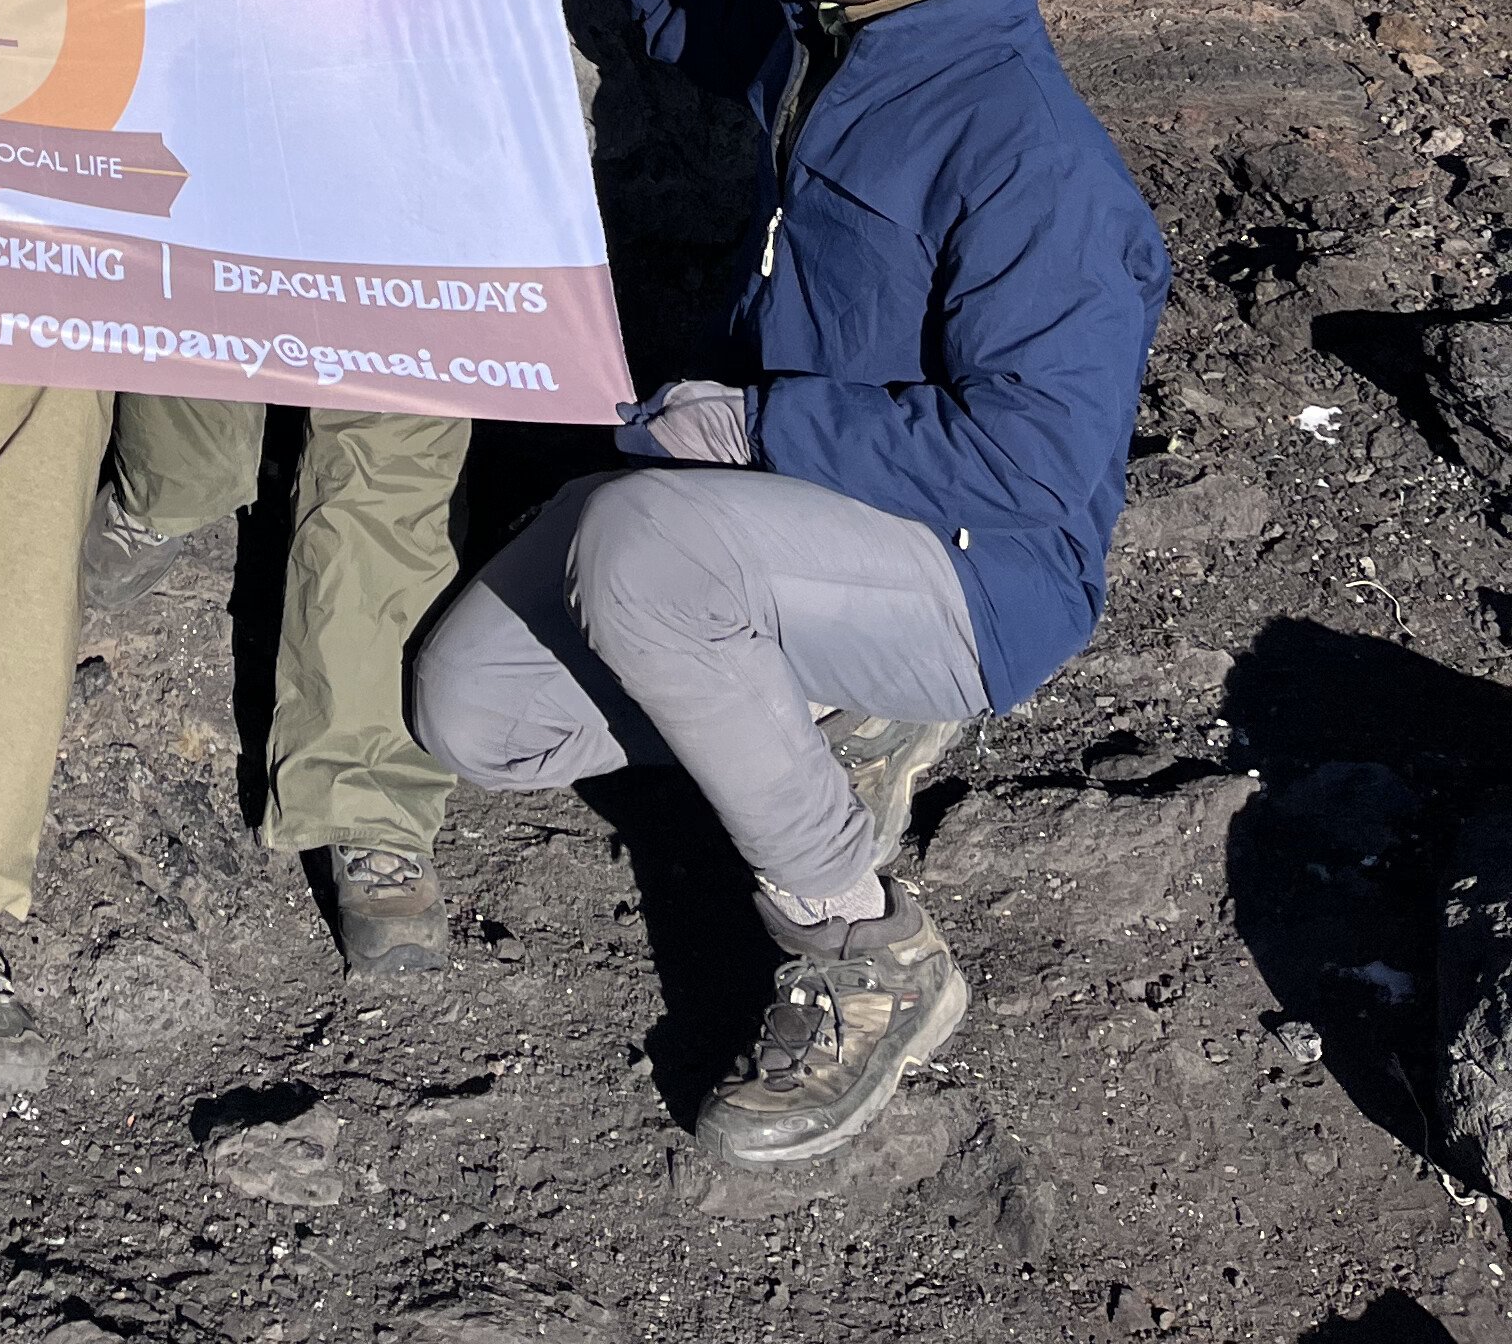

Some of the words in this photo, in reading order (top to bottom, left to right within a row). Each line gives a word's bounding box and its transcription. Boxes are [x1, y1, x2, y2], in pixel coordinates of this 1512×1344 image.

[75, 153, 124, 180] LIFE
[213, 259, 347, 304] BEACH
[355, 276, 548, 314] HOLIDAYS
